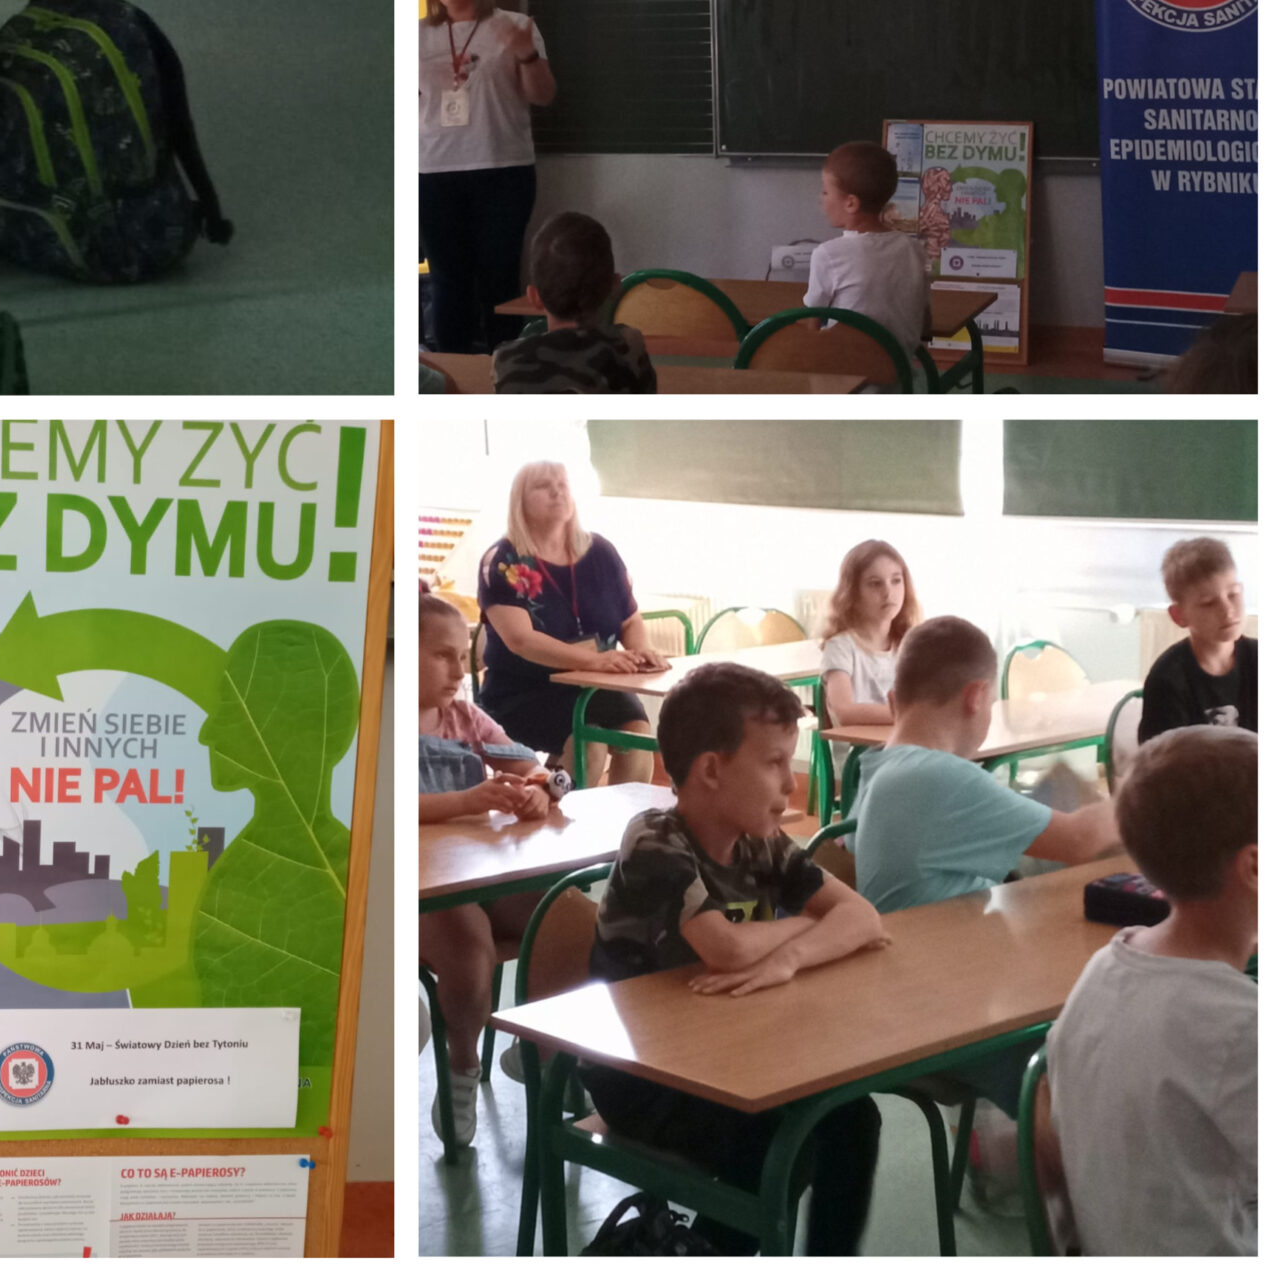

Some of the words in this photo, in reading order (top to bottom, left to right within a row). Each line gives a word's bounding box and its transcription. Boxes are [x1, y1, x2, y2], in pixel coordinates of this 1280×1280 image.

[1103, 78, 1225, 99] POWIATOWA
[1231, 78, 1258, 99] ST
[925, 131, 985, 144] CHCEMY
[924, 145, 959, 159] BEZ
[1152, 170, 1171, 190] W
[12, 708, 96, 734] ZMIEŃ
[105, 713, 186, 735] SIEBIE
[41, 737, 45, 757] I
[56, 737, 157, 759] INNYCH
[10, 767, 81, 803] NIE
[94, 768, 184, 804] PAL!
[71, 1042, 82, 1050] 31
[85, 1041, 104, 1051] Maj
[115, 1039, 161, 1050] Światowy
[164, 1040, 190, 1049] Dzień
[193, 1040, 209, 1049] bez
[212, 1039, 248, 1050] Tytoniu
[90, 1076, 135, 1086] Jabłuszko
[138, 1076, 174, 1085] zamiast
[177, 1076, 224, 1086] papierosa
[227, 1076, 230, 1084] !
[20, 1169, 45, 1177] DZIECI
[121, 1168, 134, 1178] CO
[138, 1168, 152, 1178] TO
[154, 1168, 167, 1181] SĄ
[170, 1167, 245, 1178] E-PAPIEROSY?
